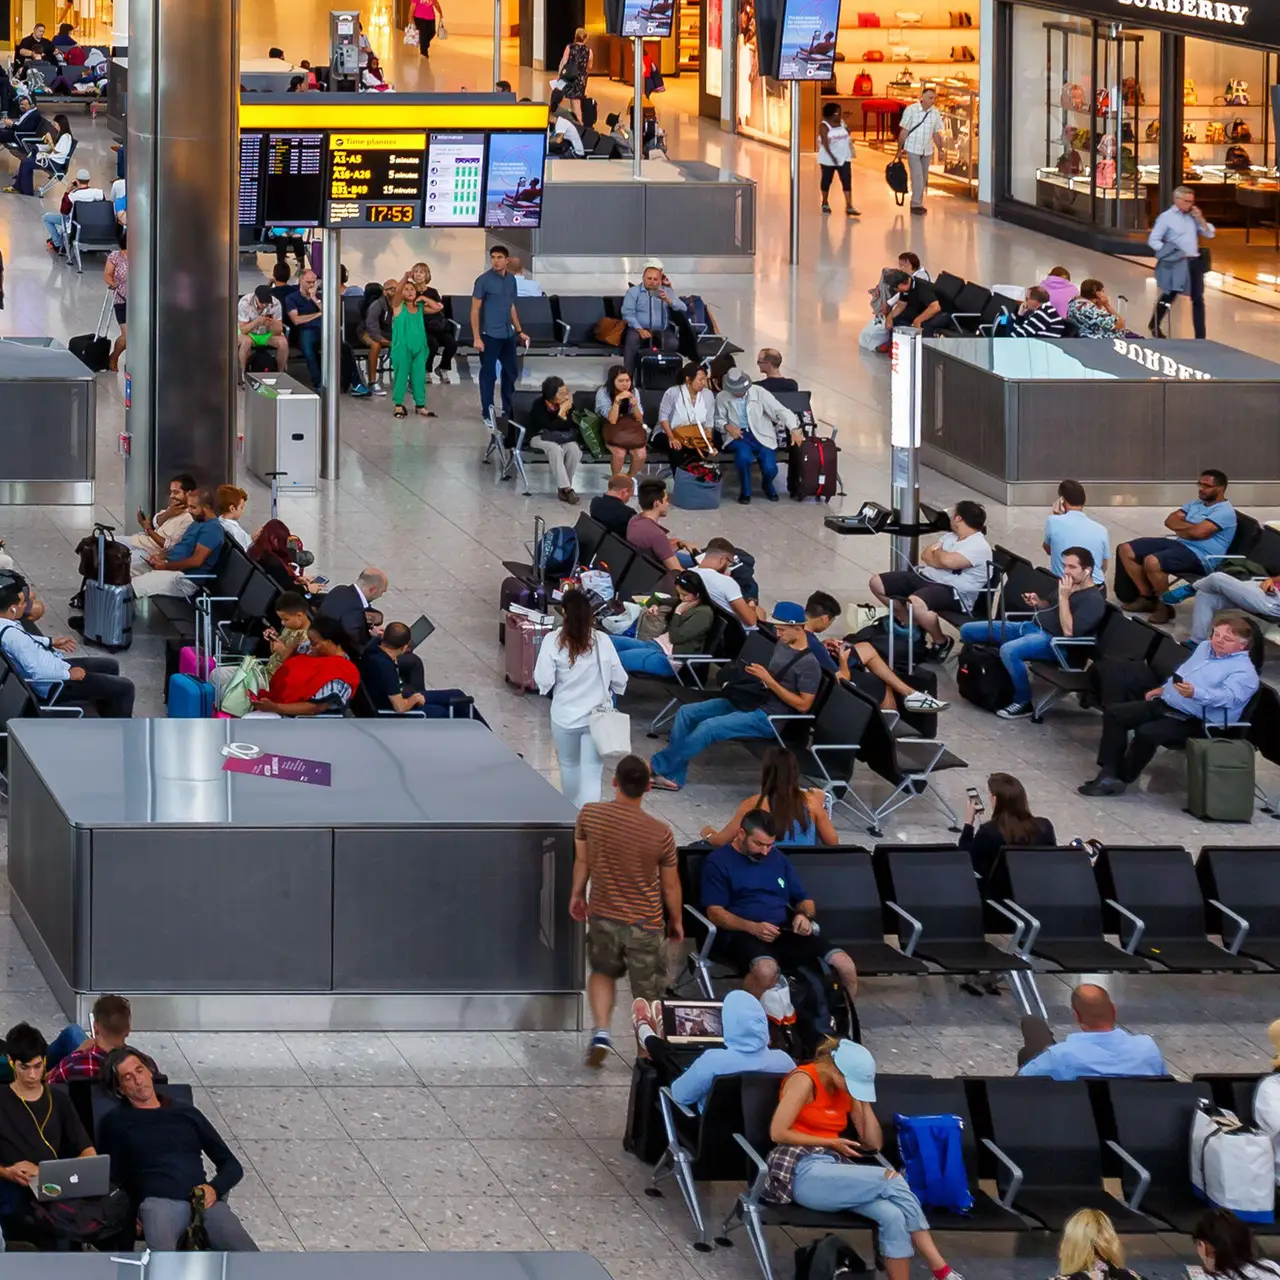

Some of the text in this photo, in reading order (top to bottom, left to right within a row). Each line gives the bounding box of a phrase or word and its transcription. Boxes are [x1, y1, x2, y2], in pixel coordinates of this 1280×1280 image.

[366, 138, 397, 146] planner
[396, 156, 419, 164] minutes
[383, 185, 394, 194] 15
[371, 206, 413, 222] 17:53
